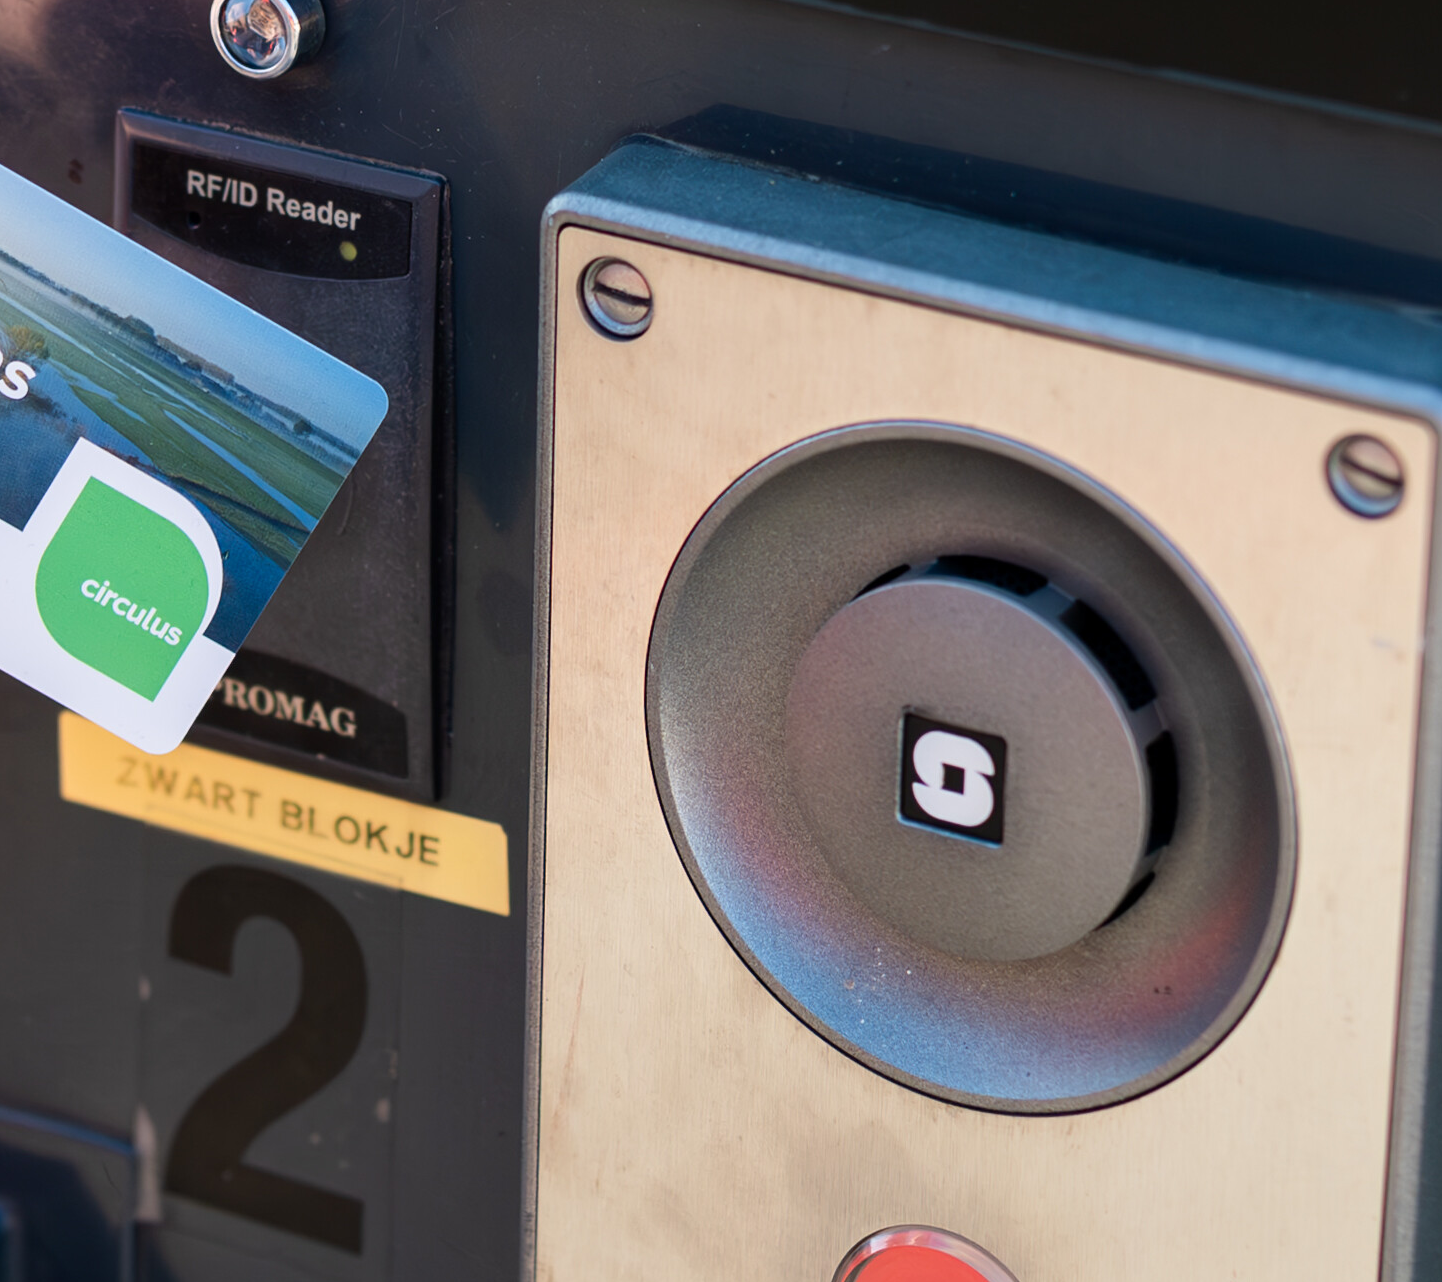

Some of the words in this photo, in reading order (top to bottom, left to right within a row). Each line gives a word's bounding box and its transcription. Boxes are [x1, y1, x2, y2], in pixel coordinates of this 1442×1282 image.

[186, 170, 259, 208] RF/ID
[266, 187, 362, 231] Reader
[80, 578, 183, 646] circulus
[116, 754, 262, 820] ZWART
[280, 798, 441, 867] BLOKJE
[164, 864, 368, 1256] 2
